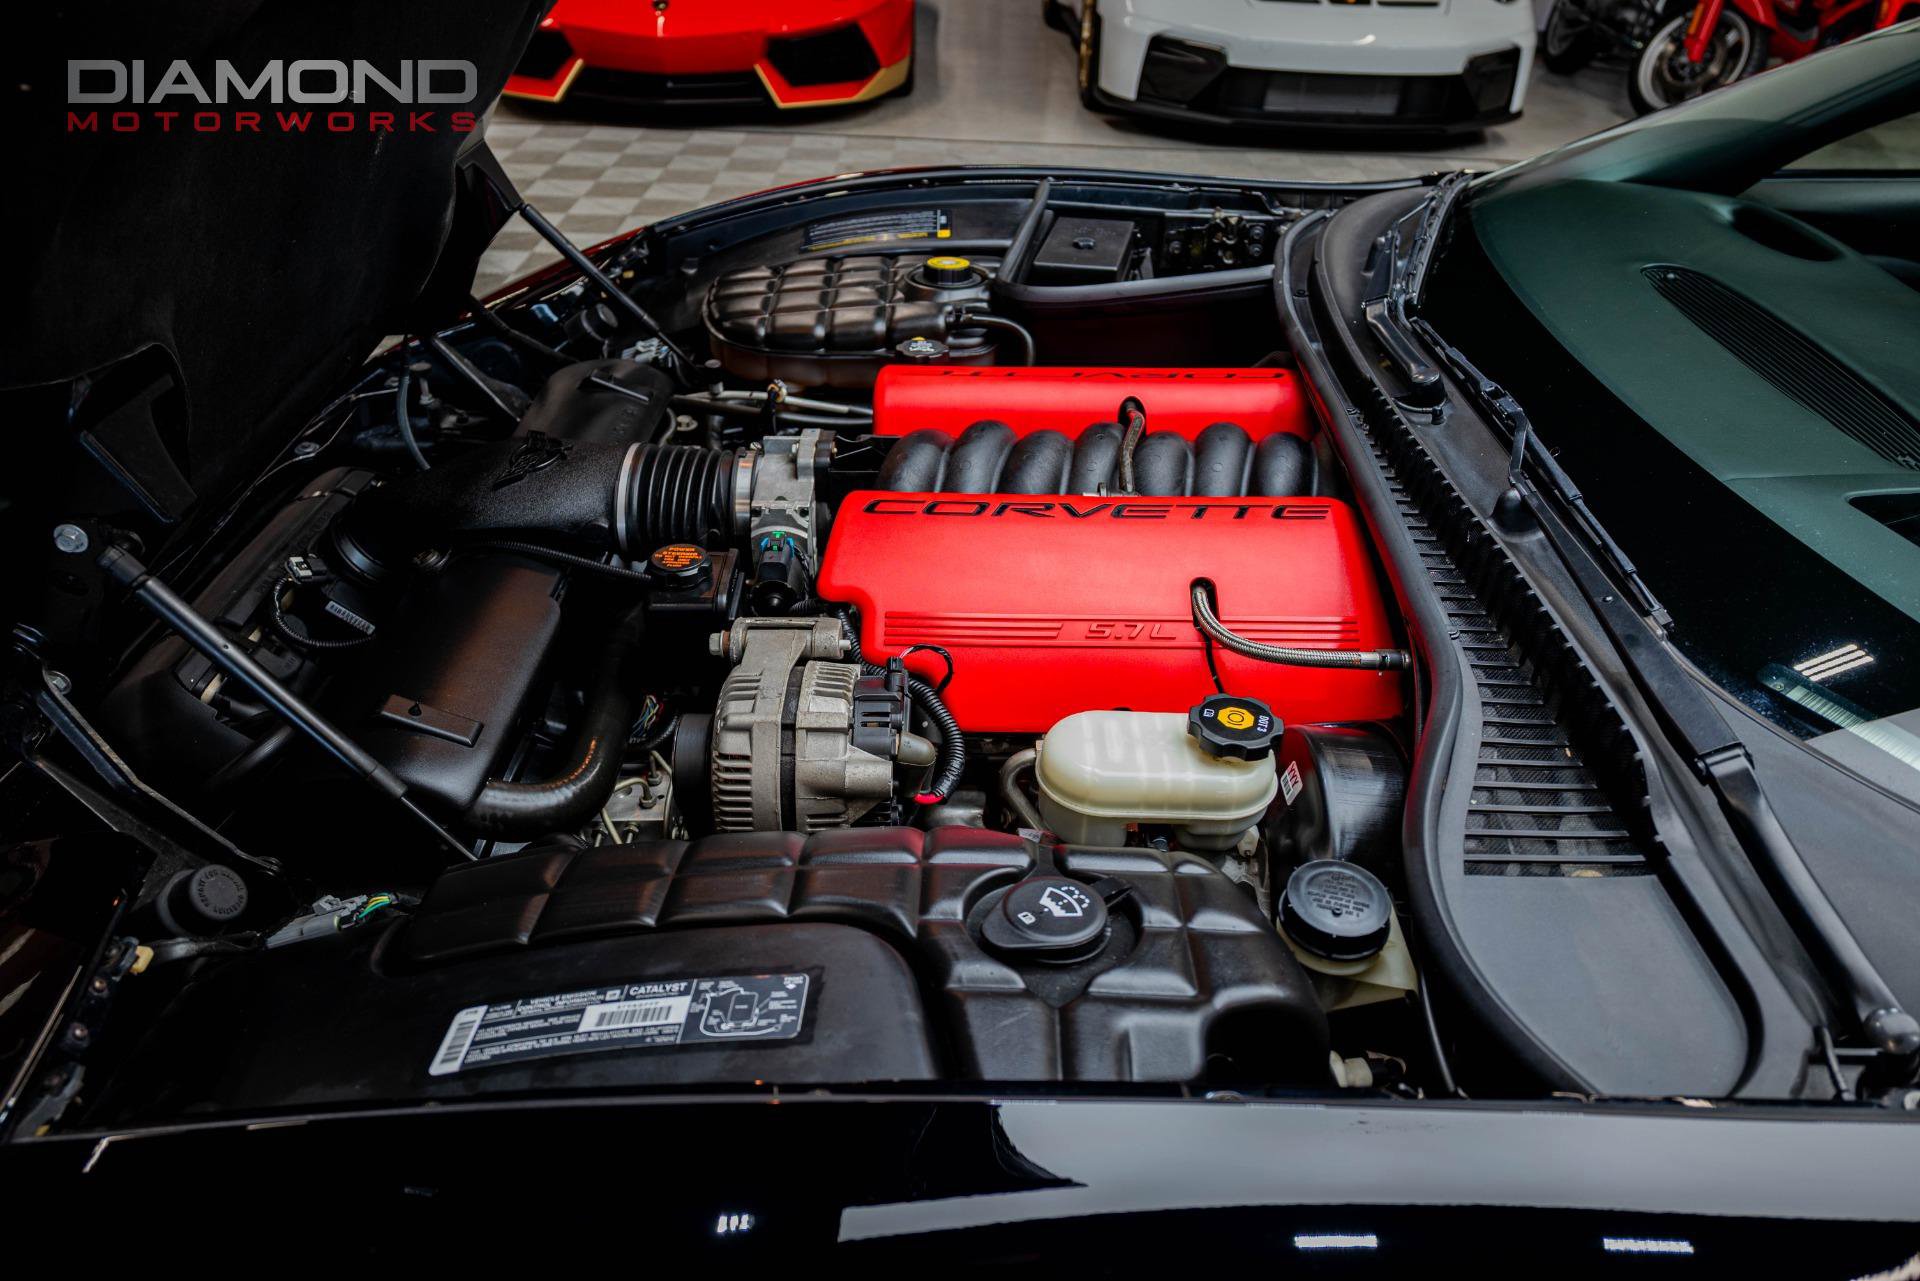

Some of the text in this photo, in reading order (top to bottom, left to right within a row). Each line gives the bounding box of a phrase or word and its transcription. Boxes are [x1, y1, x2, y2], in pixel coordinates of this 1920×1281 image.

[862, 499, 1331, 521] CORVETTE
[1085, 622, 1177, 641] 5.7L
[1256, 714, 1270, 734] DOT 3
[629, 981, 688, 996] CATALYST
